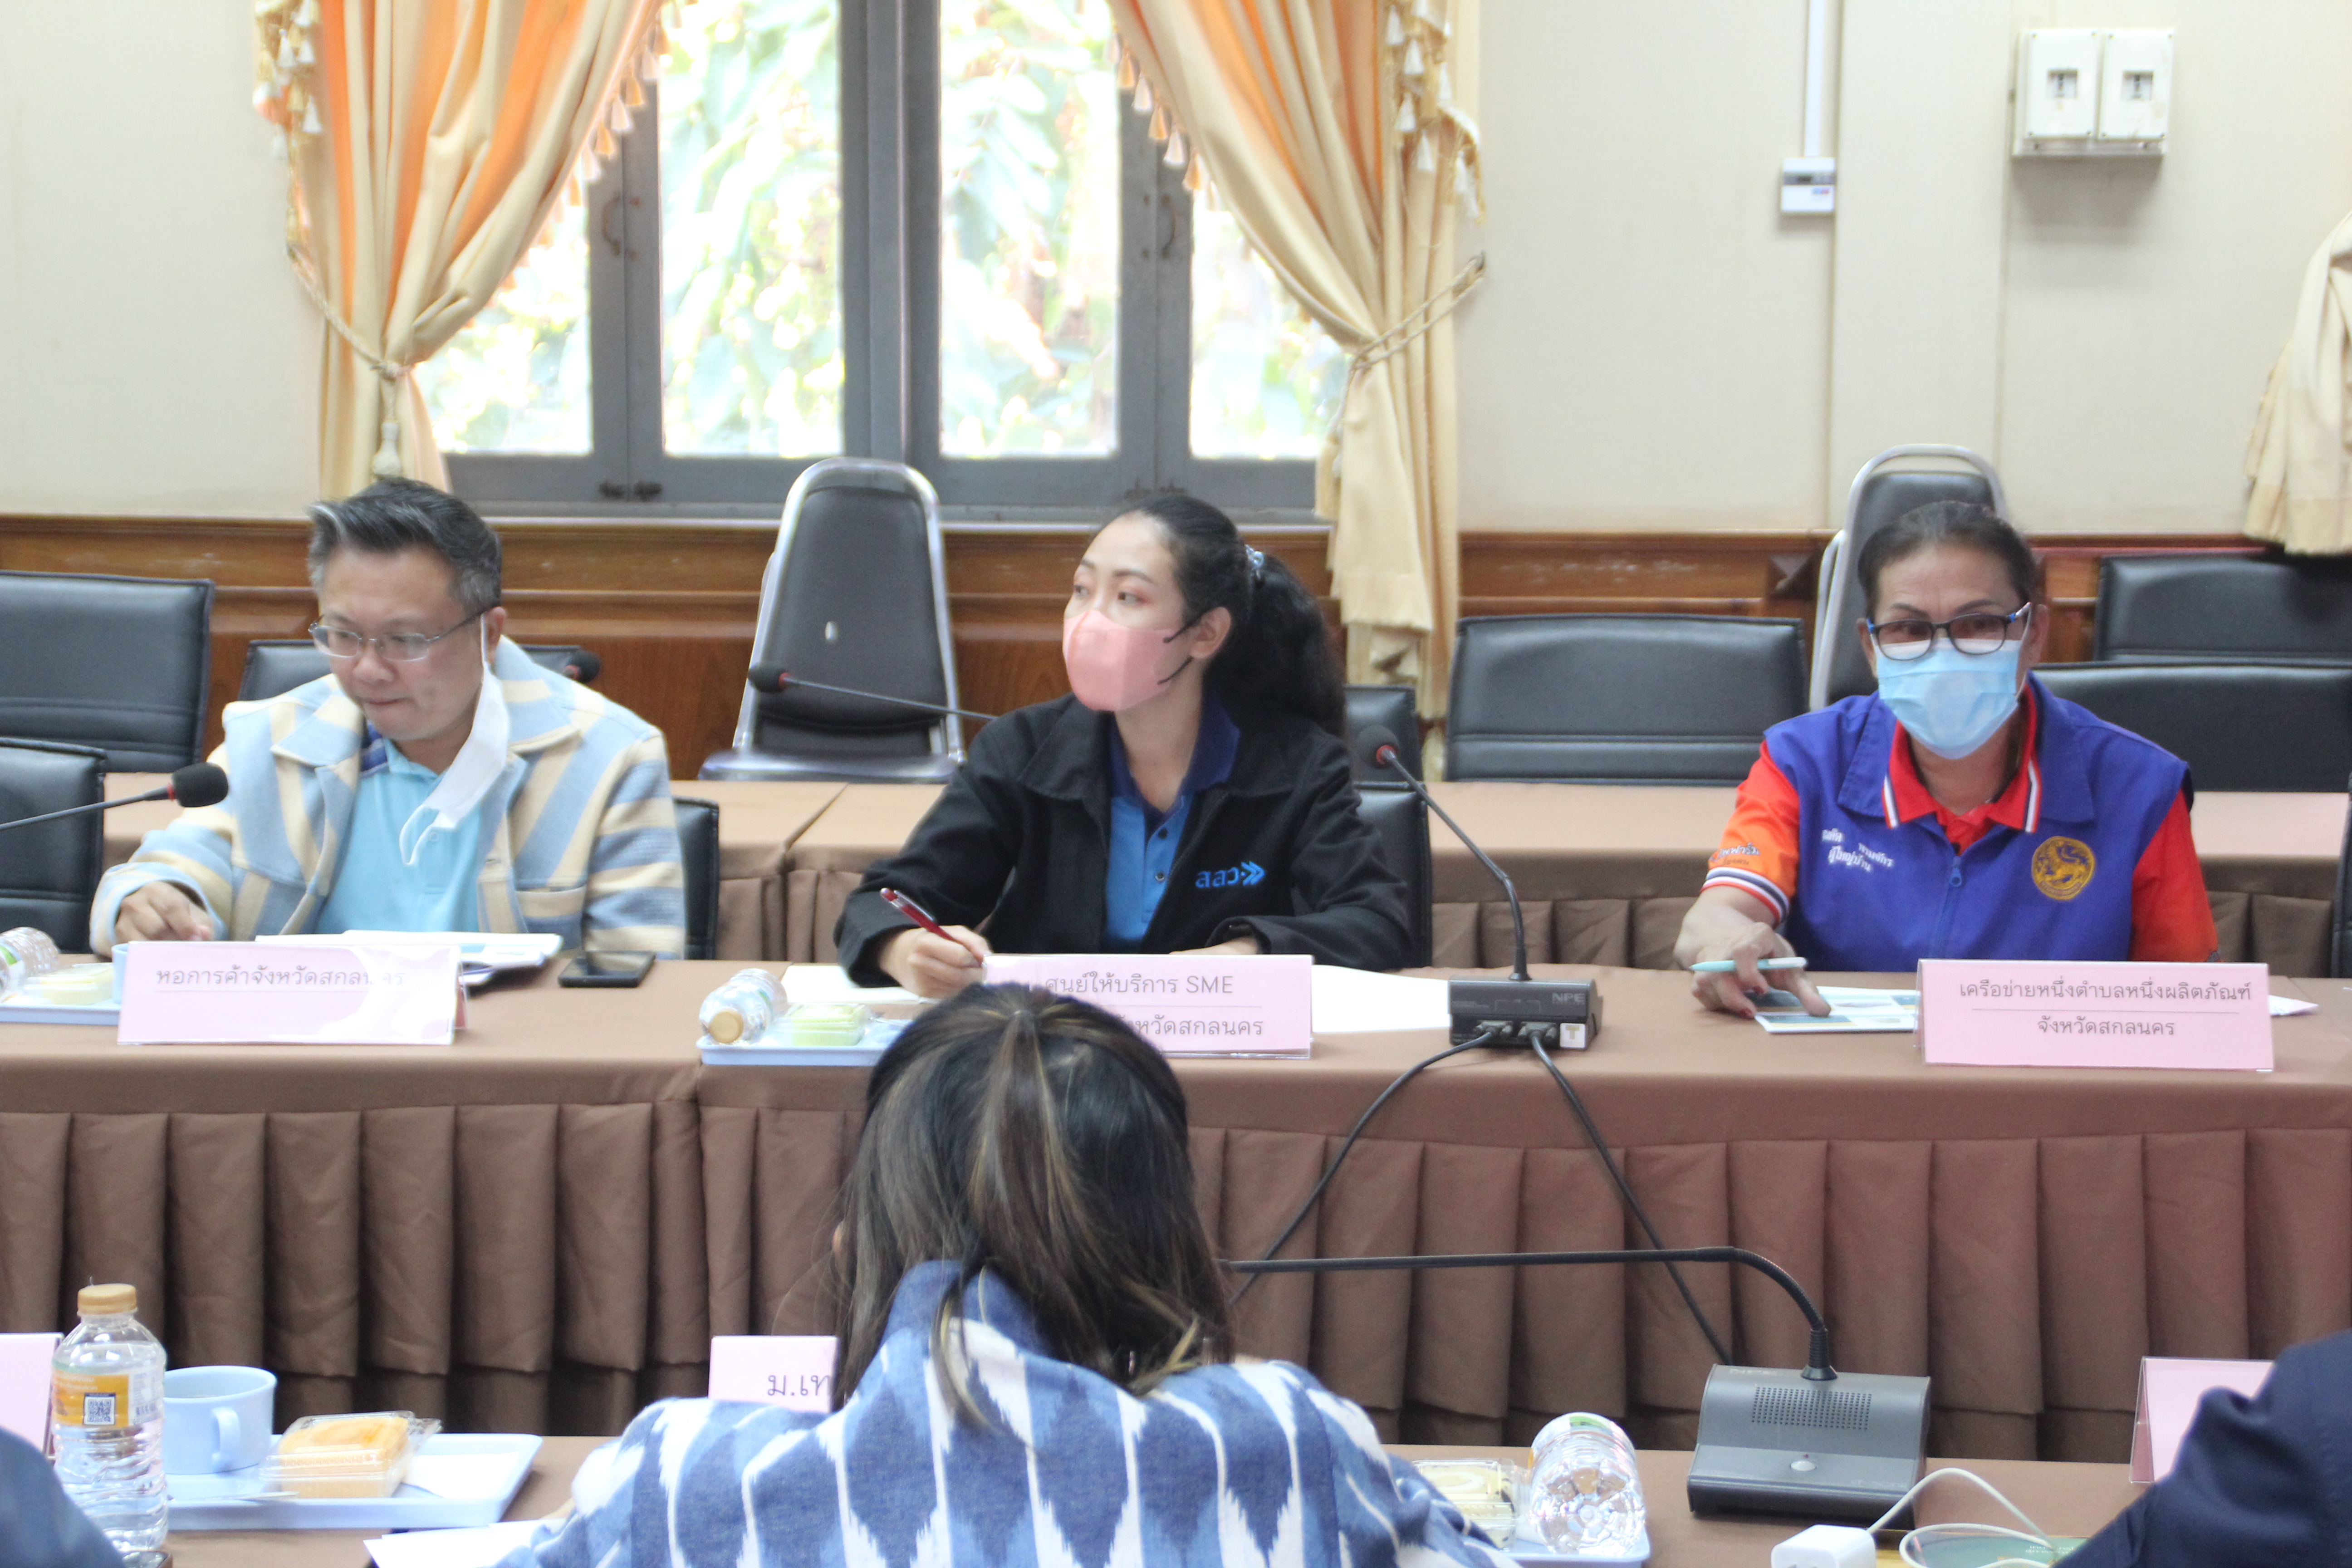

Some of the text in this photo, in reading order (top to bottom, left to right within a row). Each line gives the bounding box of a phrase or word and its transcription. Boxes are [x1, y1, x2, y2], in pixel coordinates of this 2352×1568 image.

[1045, 970, 1233, 994] ศนย์ให้บริการ SME
[1960, 975, 2251, 1000] เครือข่ายหนึ่งตำบลหนึ่งผลิตภัณฑ์
[1552, 992, 1586, 1004] NPE
[2038, 1014, 2175, 1035] จังหวัดสกลนคร
